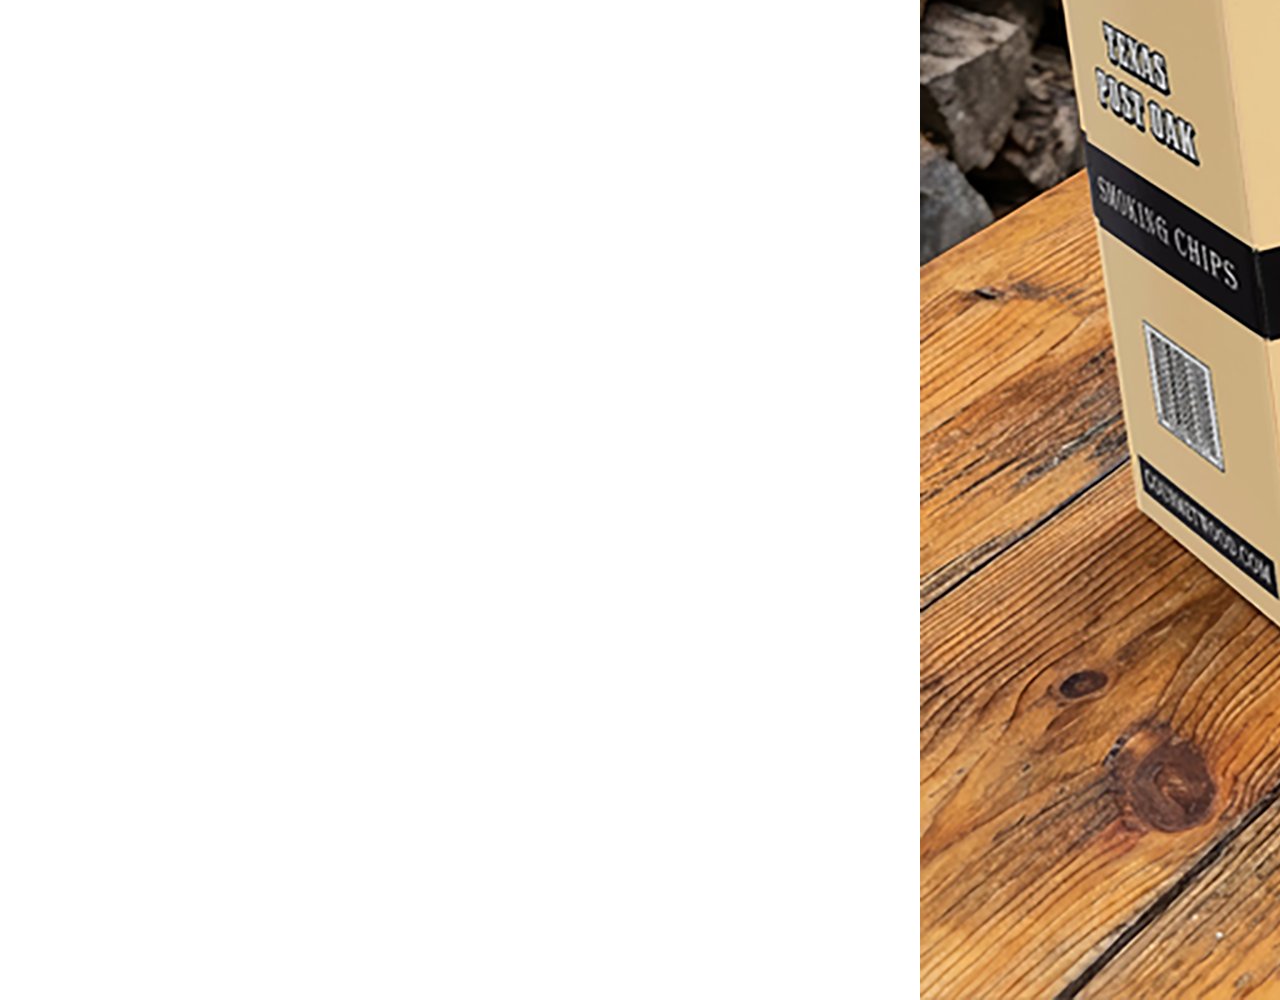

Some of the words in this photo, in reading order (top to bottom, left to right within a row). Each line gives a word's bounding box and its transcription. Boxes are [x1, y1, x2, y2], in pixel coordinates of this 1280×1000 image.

[1101, 20, 1172, 97] TEXAS
[1094, 66, 1147, 134] POST
[1146, 99, 1202, 168] OAK
[1097, 175, 1170, 246] SMOKING
[1173, 227, 1240, 291] CHIPS
